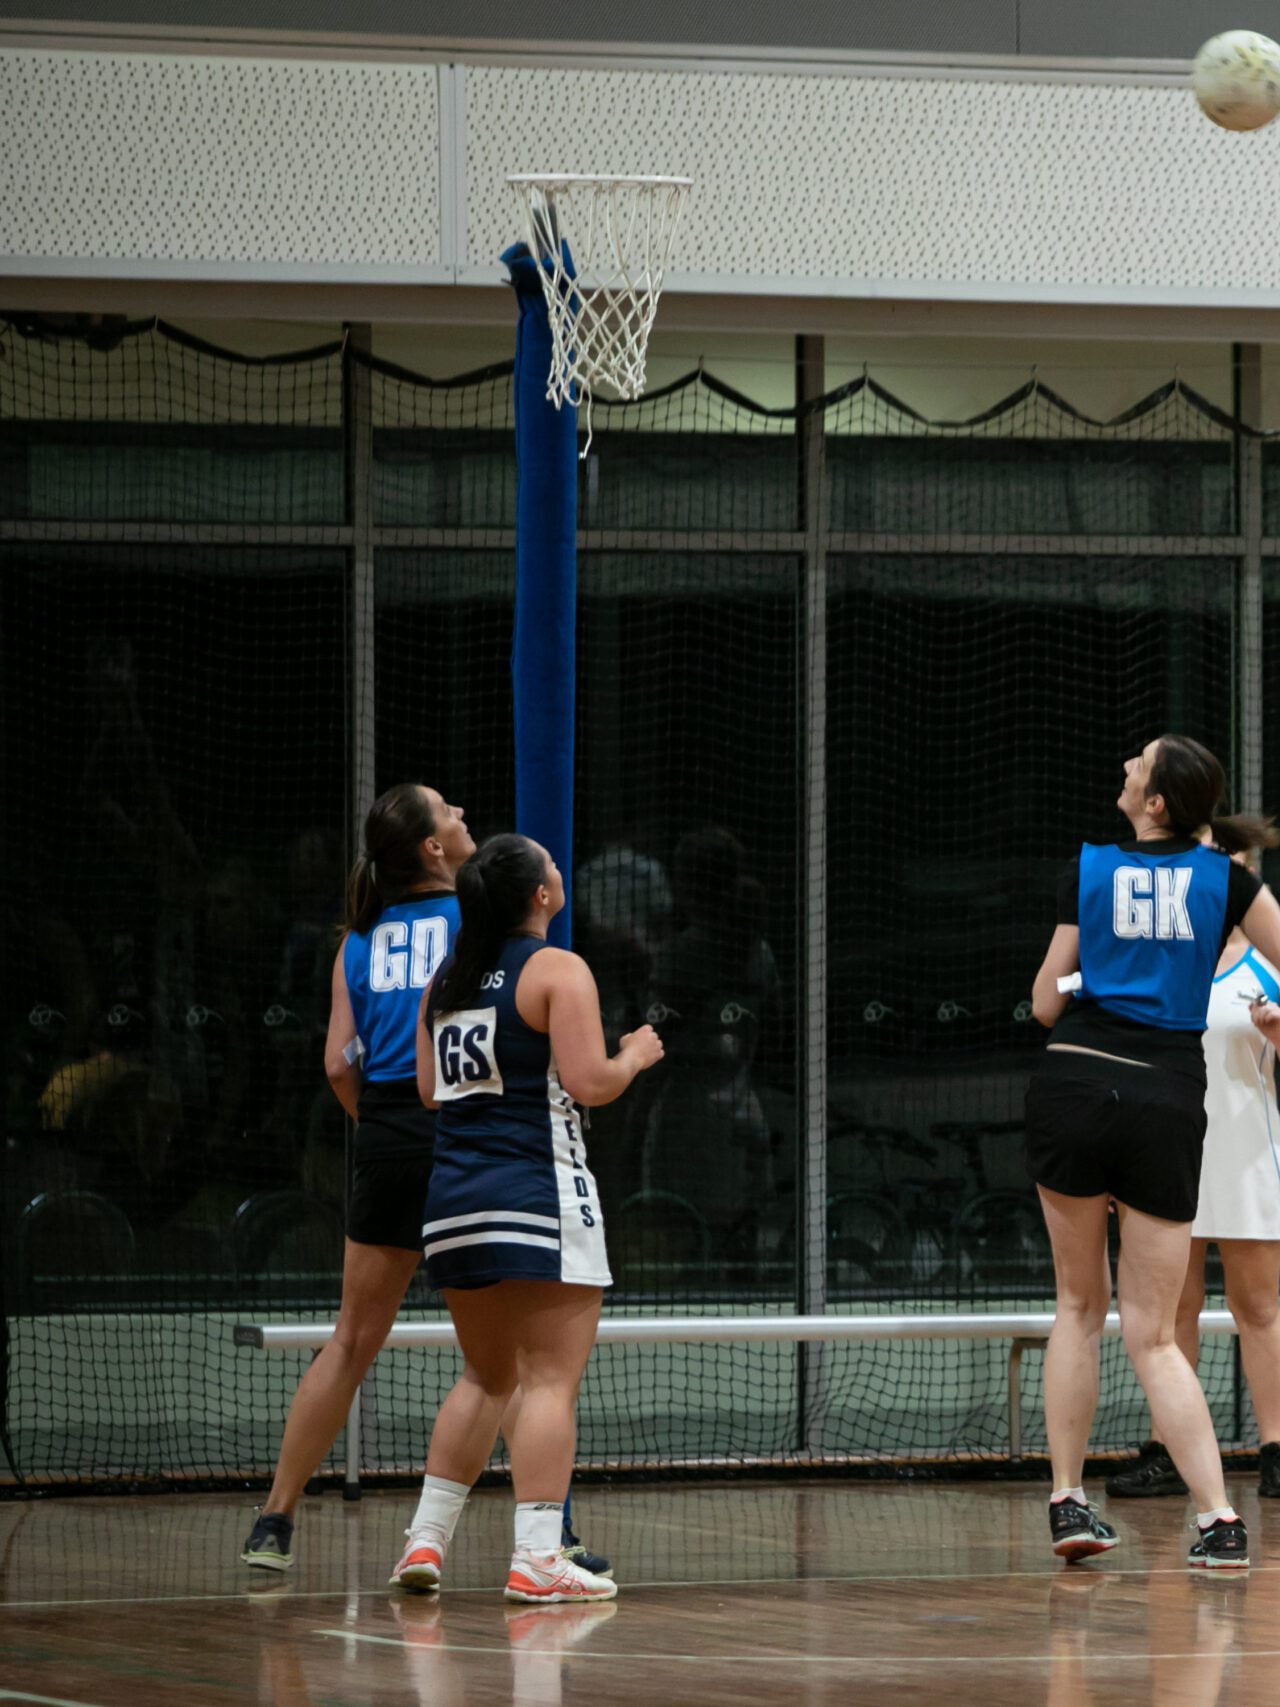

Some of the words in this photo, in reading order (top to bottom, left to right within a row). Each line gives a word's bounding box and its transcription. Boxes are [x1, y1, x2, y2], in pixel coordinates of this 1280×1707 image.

[1113, 867, 1194, 940] GK
[370, 916, 449, 992] GD
[439, 1025, 493, 1085] GS
